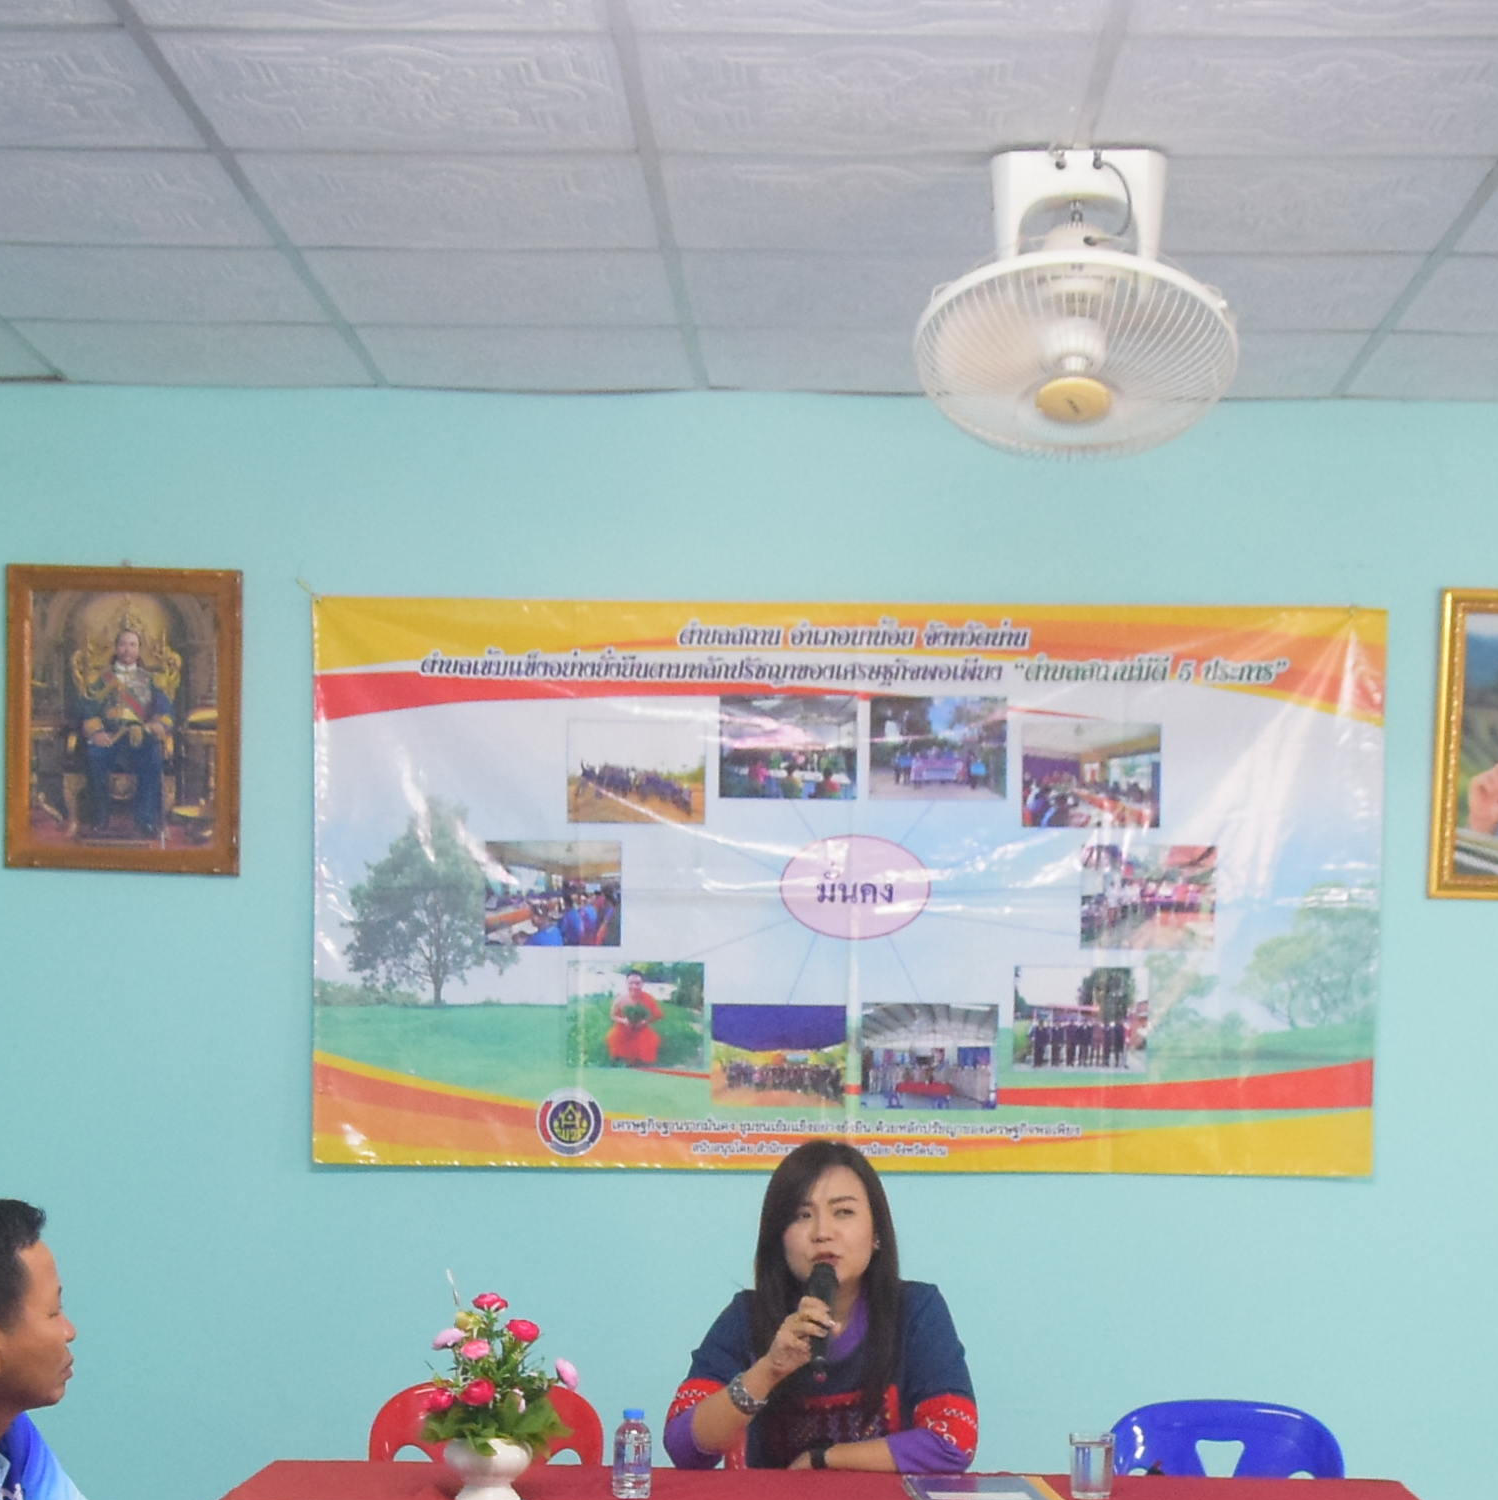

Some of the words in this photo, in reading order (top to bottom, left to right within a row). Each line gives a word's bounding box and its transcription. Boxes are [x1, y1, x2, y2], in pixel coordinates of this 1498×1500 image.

[1177, 660, 1194, 682] 5
[816, 861, 894, 904] มั่นคง
